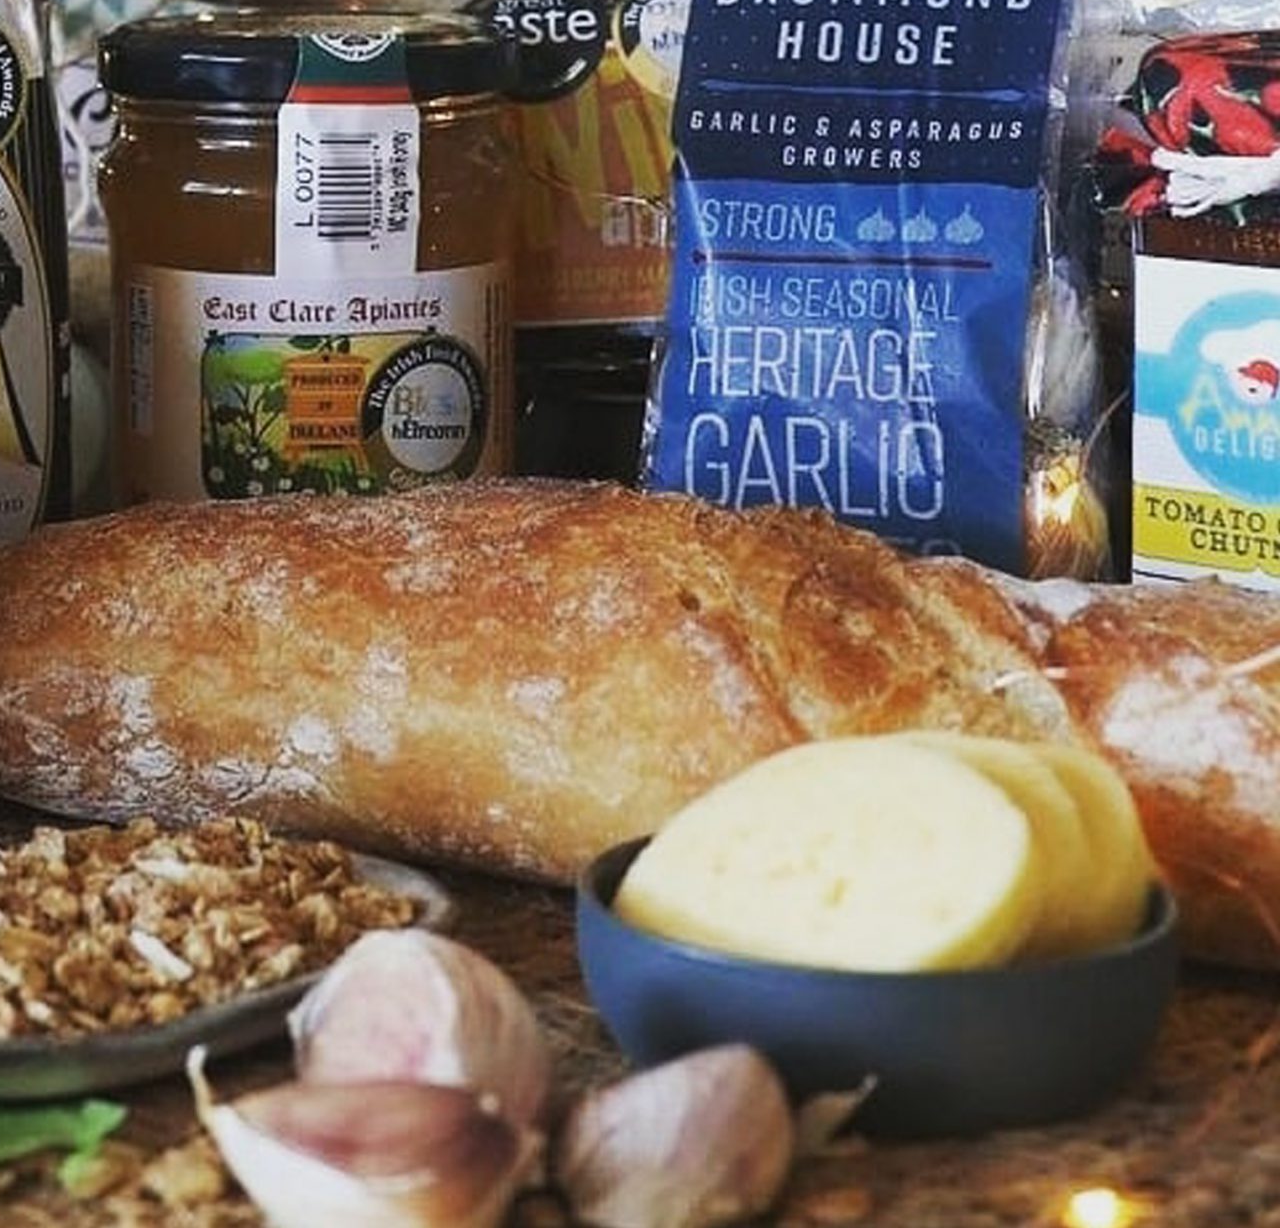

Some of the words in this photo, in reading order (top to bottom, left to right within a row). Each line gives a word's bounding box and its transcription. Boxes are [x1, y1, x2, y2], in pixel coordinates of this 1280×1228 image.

[494, 8, 599, 45] aste
[776, 19, 959, 67] HOUSE
[689, 109, 797, 135] GARLIC
[848, 118, 1024, 143] ASPARAGUS
[295, 132, 314, 203] 0077
[781, 145, 922, 170] GROWERS
[294, 210, 314, 228] L
[698, 198, 837, 244] STRONG
[202, 296, 257, 322] East
[267, 298, 335, 325] Clare
[689, 275, 771, 323] IRISH
[782, 277, 961, 323] SEASONAL
[687, 325, 939, 404] HERITAGE
[1145, 495, 1266, 534] TOMATO
